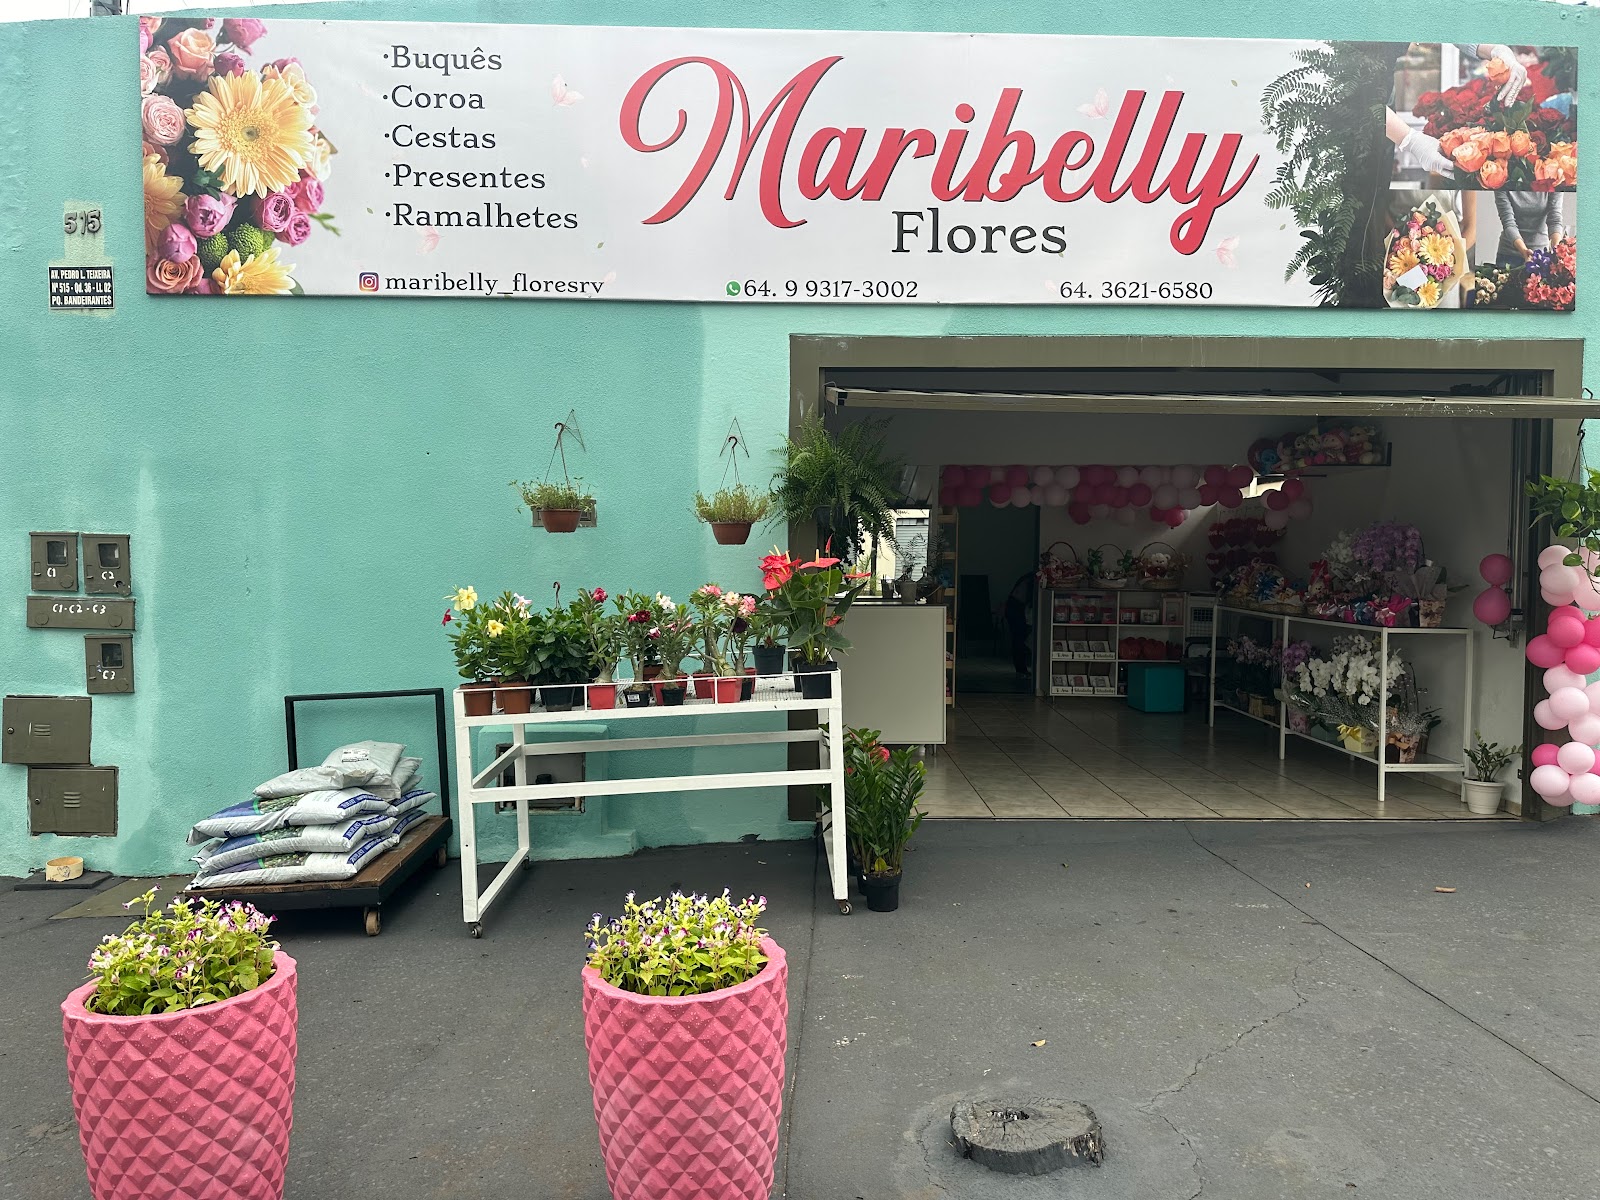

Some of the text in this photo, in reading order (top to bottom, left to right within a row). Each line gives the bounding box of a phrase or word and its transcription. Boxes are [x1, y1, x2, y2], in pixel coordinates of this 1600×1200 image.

[391, 45, 503, 77] Buquês
[391, 84, 486, 110] Coroa
[392, 124, 497, 149] Cestas
[619, 56, 1260, 256] Maribelly
[392, 163, 546, 189] Presentes
[64, 209, 102, 237] 515
[393, 202, 579, 229] Ramalhetes
[891, 207, 1067, 254] Flores
[51, 269, 60, 280] AV.
[60, 269, 79, 280] PEDRO
[86, 269, 111, 280] TEIXEIRA
[59, 282, 70, 293] 515
[84, 282, 92, 293] 36
[103, 282, 112, 293] 02
[384, 271, 605, 297] maribelly_floresrv
[51, 295, 112, 306] PQ. BANDEIRANTES
[744, 279, 918, 298] 64. 9 9317-3002
[1059, 281, 1213, 299] 64. 3621-6580
[46, 567, 56, 578] C1
